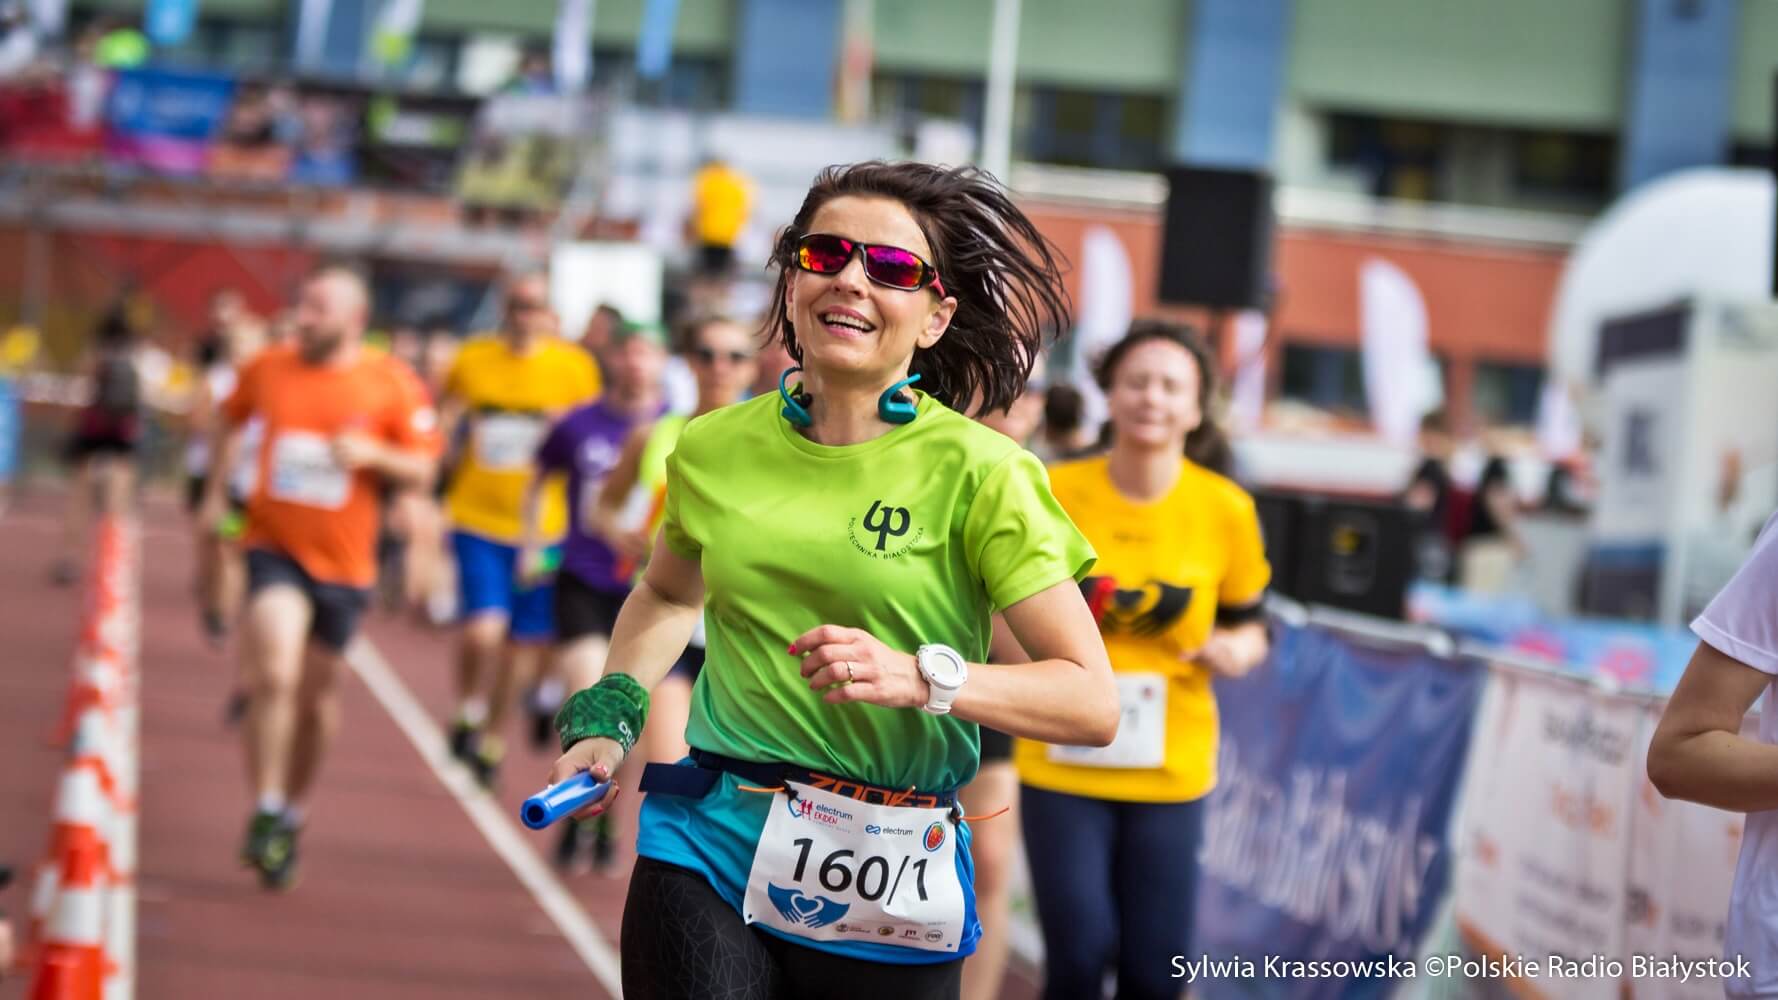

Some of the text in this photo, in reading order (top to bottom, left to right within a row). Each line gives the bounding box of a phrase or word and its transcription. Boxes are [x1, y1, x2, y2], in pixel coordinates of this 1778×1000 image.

[847, 516, 878, 560] POLITECHNIKA
[813, 811, 839, 825] EKIDEN
[815, 803, 854, 822] electrum
[882, 826, 914, 837] electrum
[792, 837, 929, 907] 160/1
